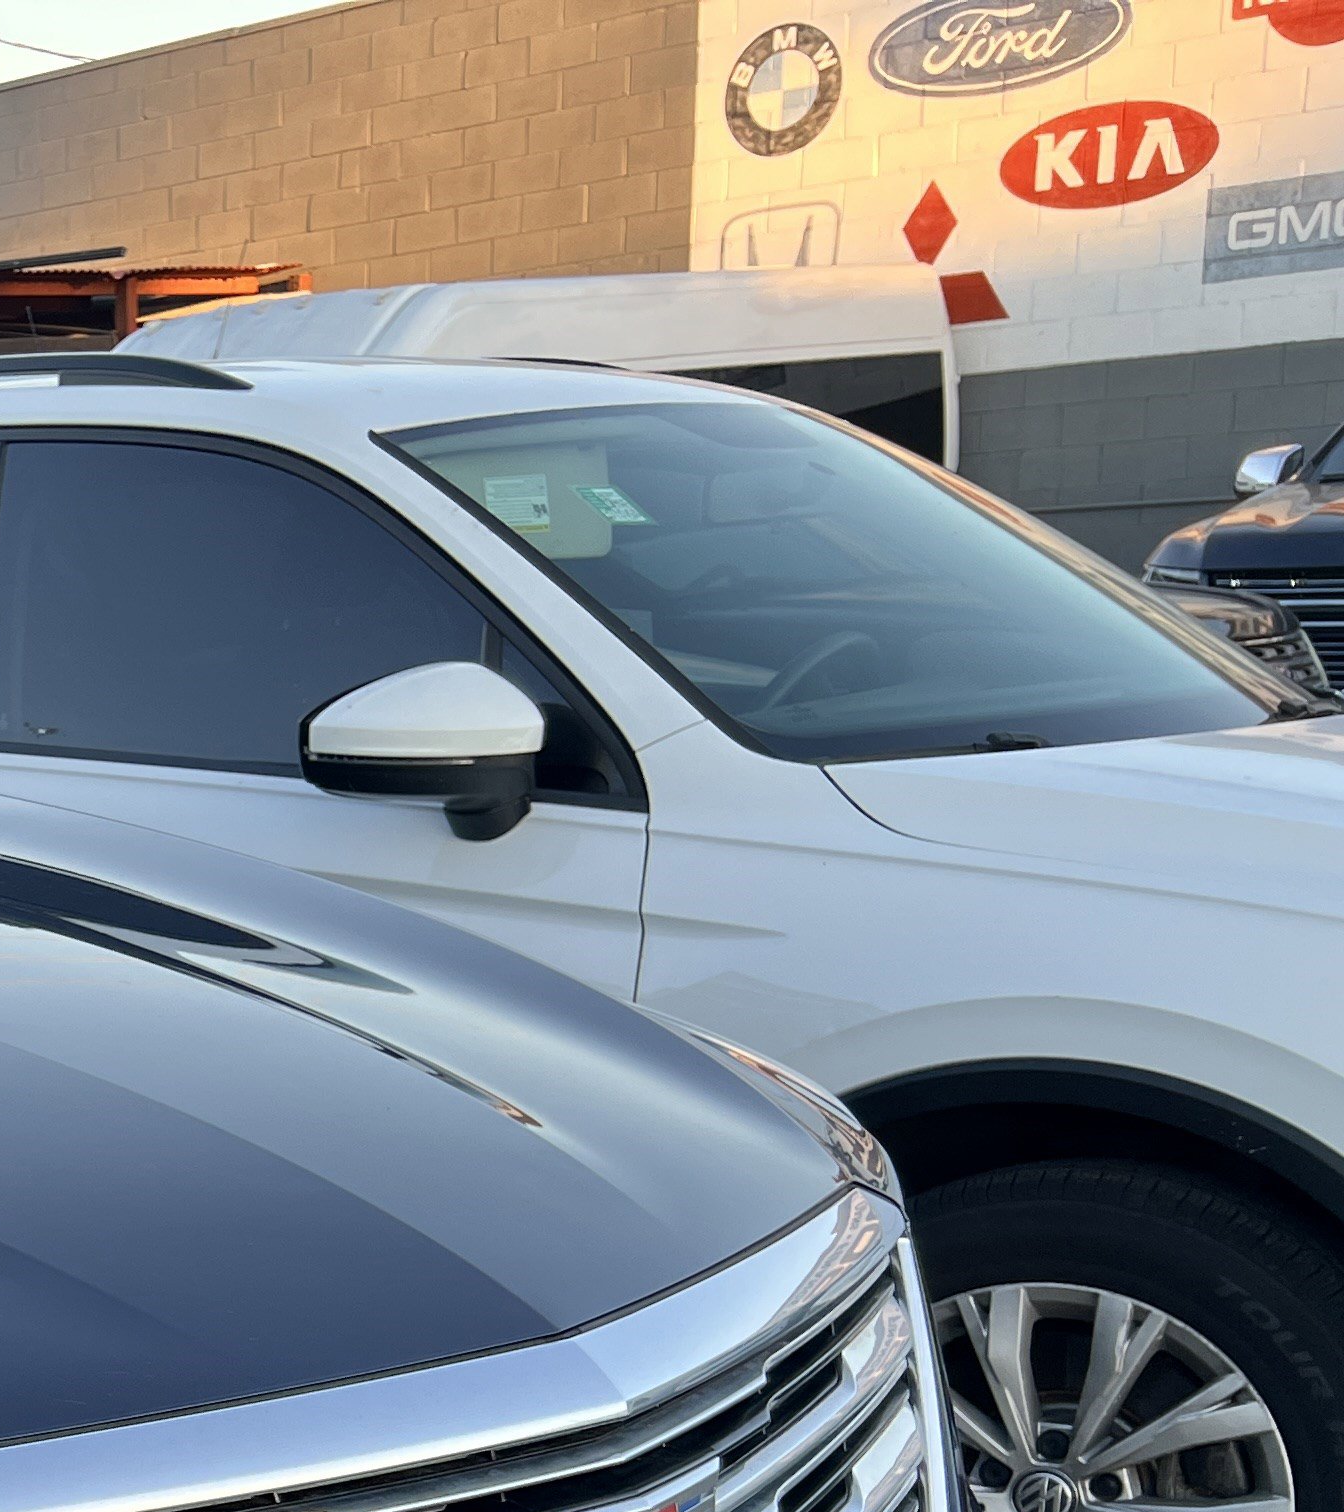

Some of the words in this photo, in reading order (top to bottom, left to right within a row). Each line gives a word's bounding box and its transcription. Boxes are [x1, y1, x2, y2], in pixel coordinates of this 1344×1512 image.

[729, 26, 839, 88] BMW
[921, 2, 1073, 76] Ford
[1033, 118, 1187, 193] KIA
[1227, 198, 1344, 251] GM
